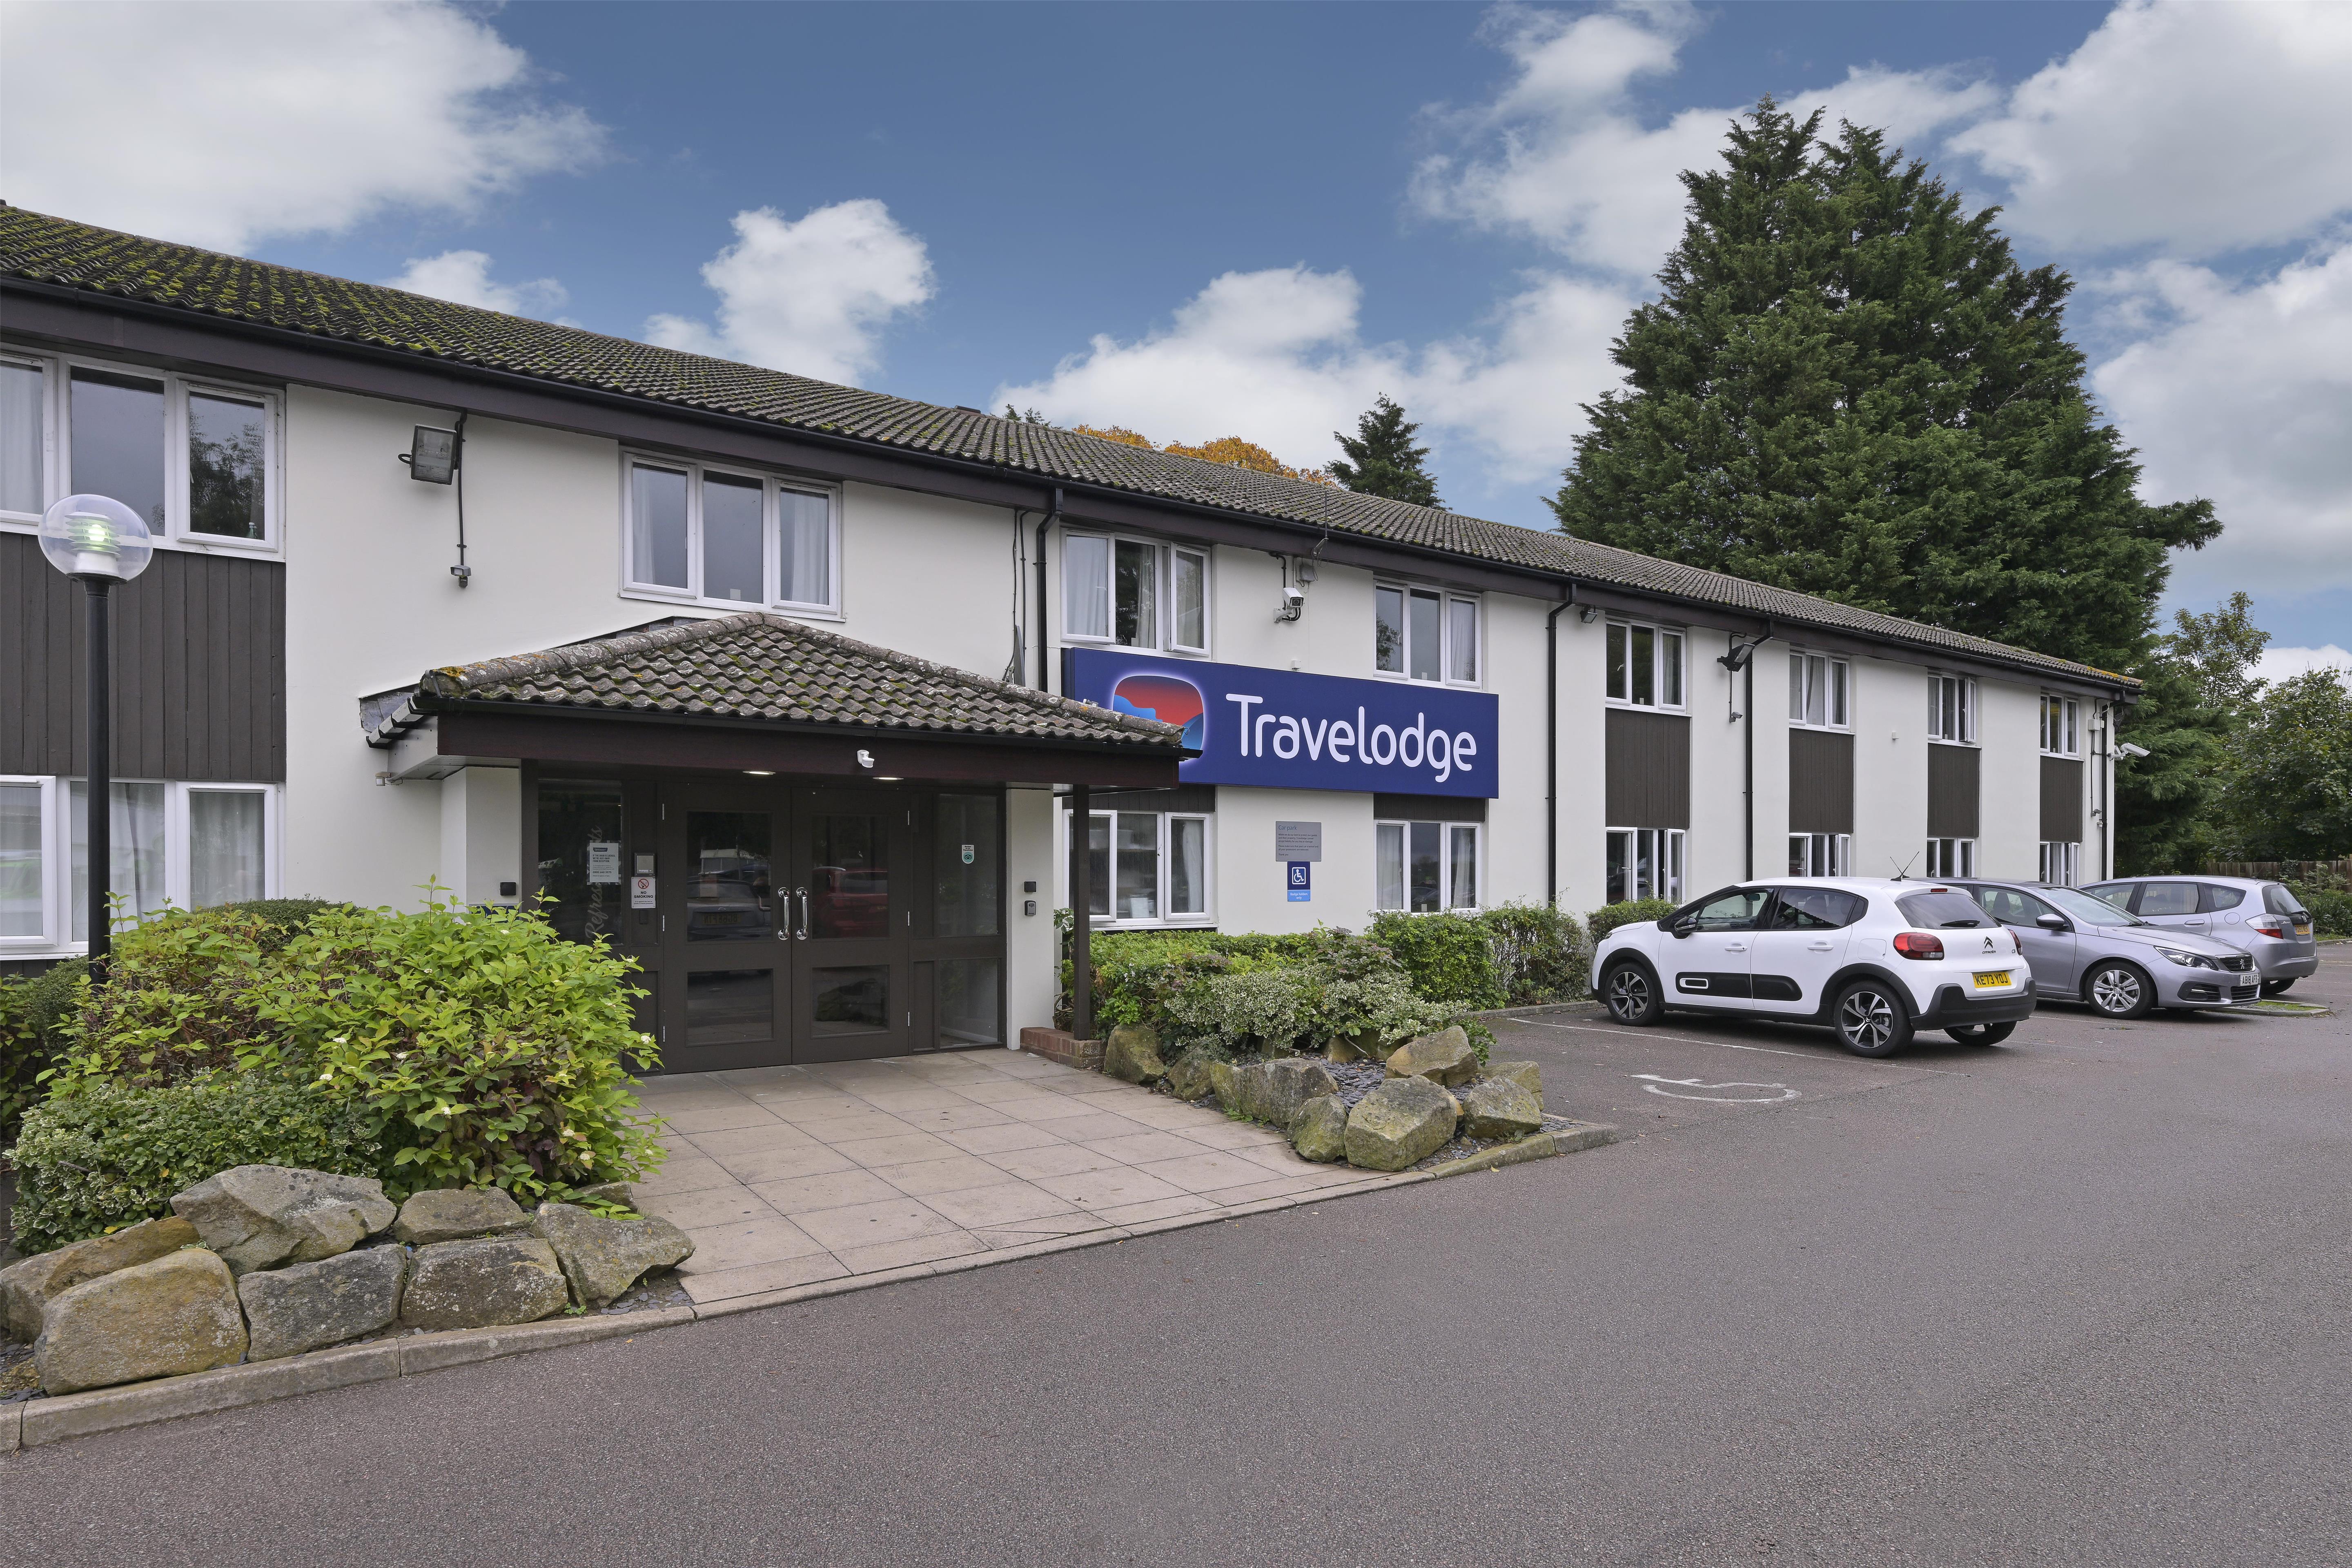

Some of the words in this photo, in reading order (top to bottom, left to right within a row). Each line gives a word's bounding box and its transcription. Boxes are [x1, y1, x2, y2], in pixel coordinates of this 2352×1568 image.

[1226, 693, 1477, 782] Travelodge
[585, 826, 608, 938] Refrests
[1975, 974, 1995, 985] KE73
[1994, 973, 2008, 984] YOJ
[2242, 976, 2251, 984] AB18
